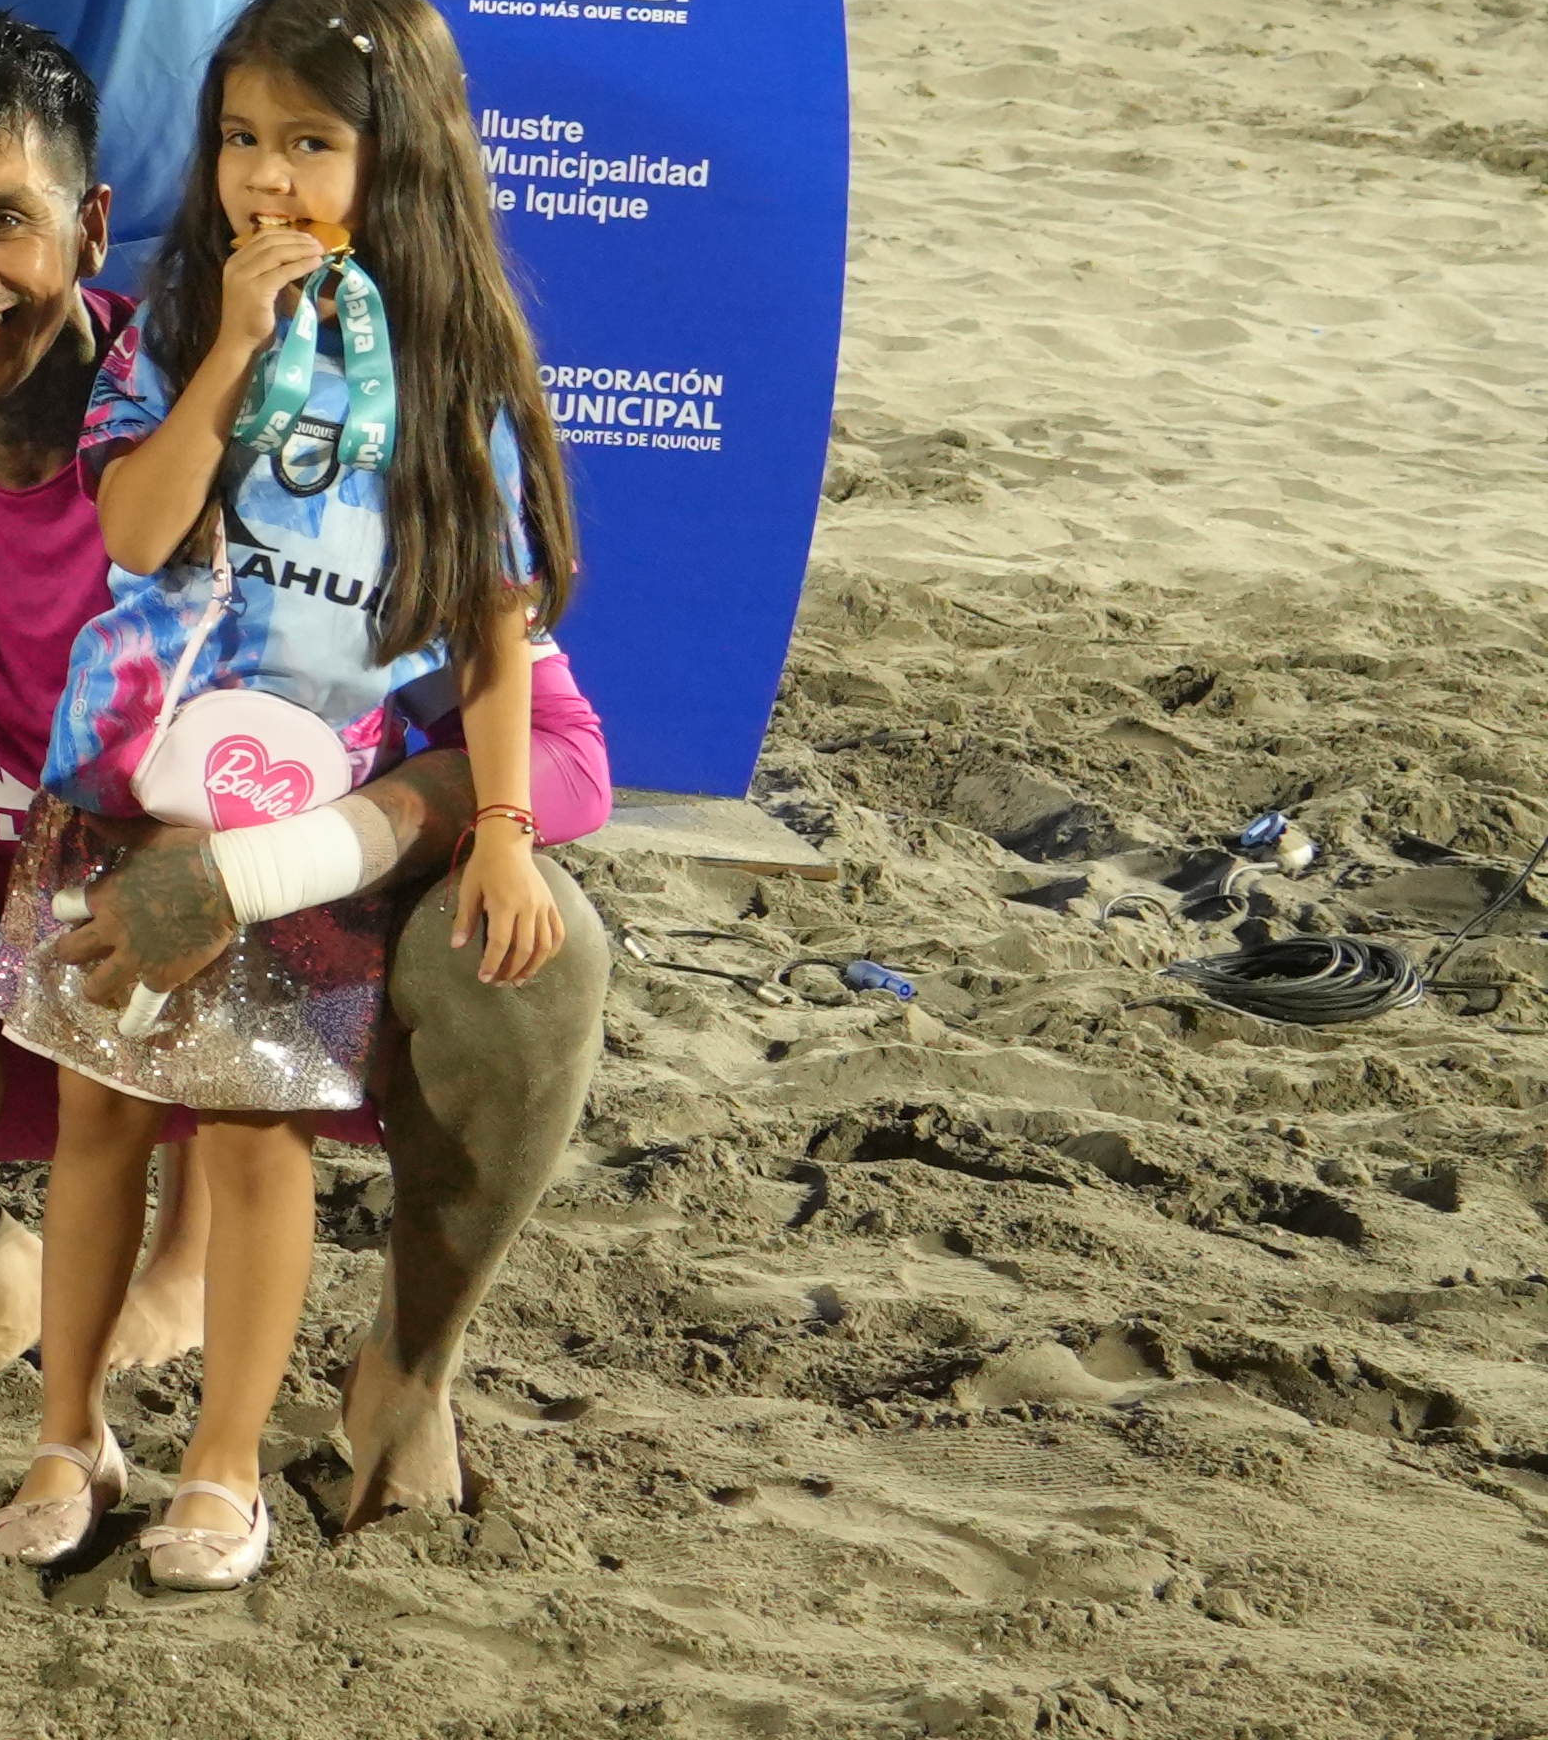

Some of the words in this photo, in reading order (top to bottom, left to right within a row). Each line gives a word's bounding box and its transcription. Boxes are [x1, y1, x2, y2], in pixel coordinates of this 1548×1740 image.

[540, 0, 579, 20] MÁS
[583, 4, 622, 22] QUE
[625, 7, 690, 26] COBRE
[480, 108, 585, 143] Ilustre
[480, 144, 710, 188] Municipalidad
[525, 183, 649, 225] Iquique
[538, 363, 724, 397] ORPORACIÓN
[545, 391, 723, 431] UNICIPAL
[294, 421, 336, 439] QUIQUE
[553, 427, 623, 447] EPORTES
[626, 431, 648, 448] DE
[651, 433, 722, 452] IQUIQUE
[205, 746, 294, 820] Barbie
